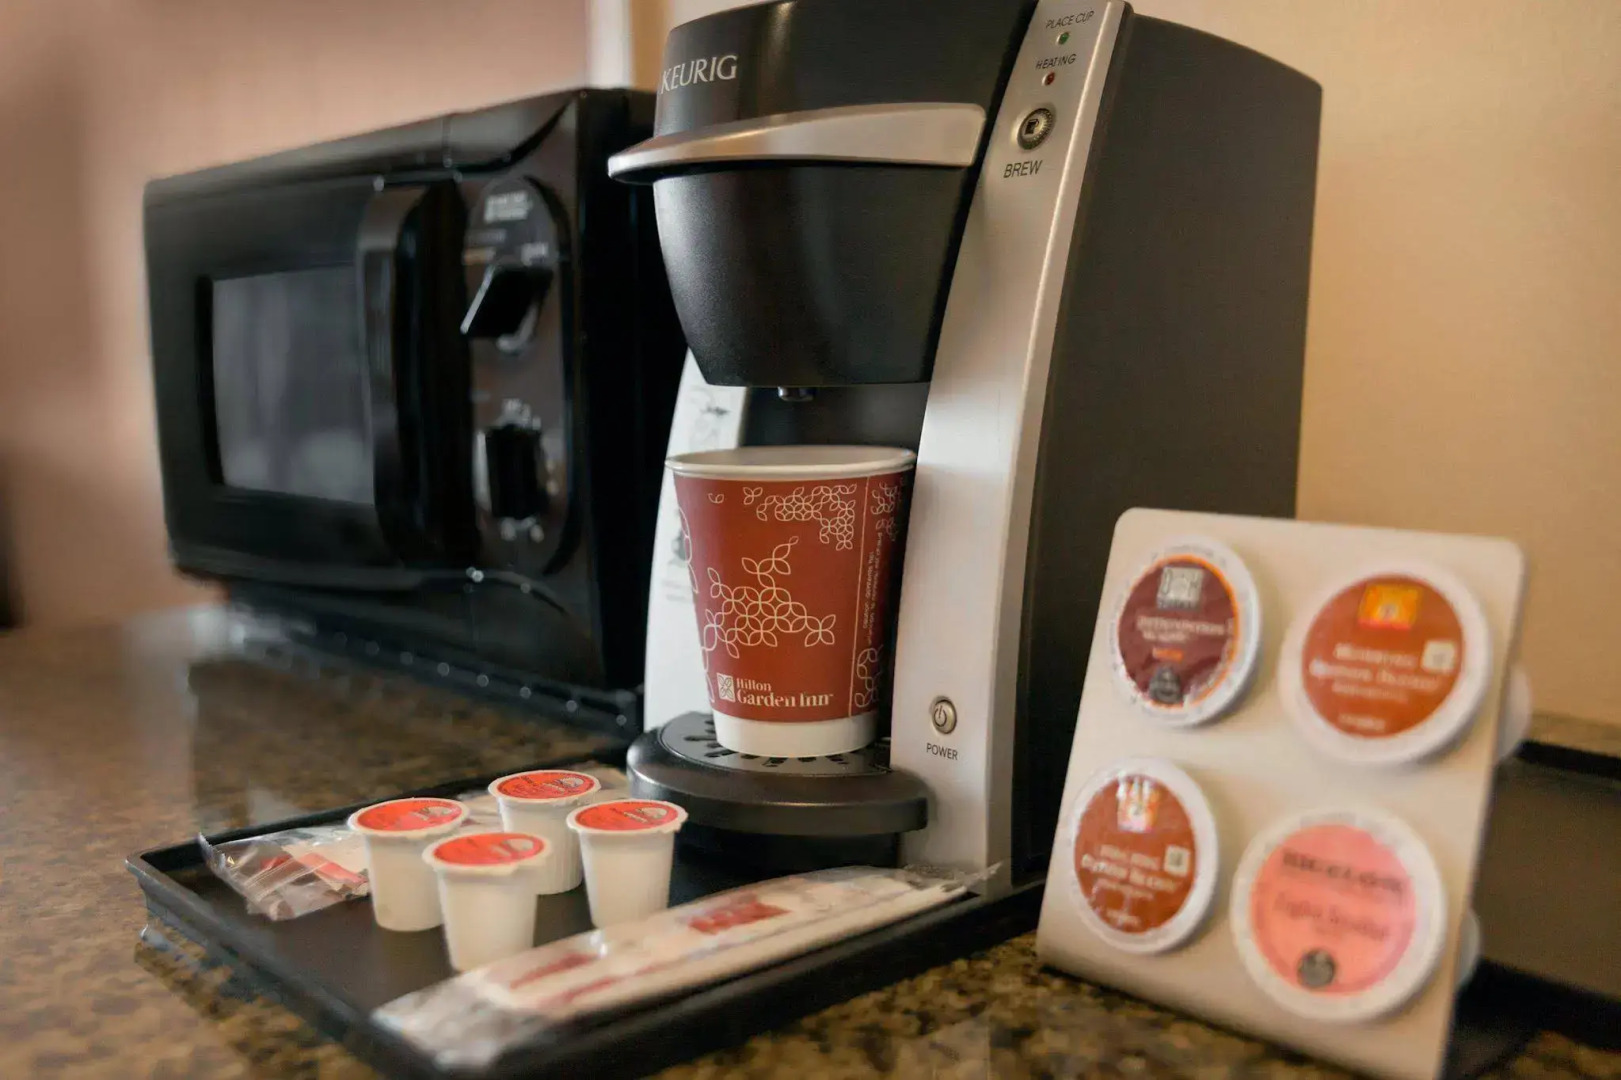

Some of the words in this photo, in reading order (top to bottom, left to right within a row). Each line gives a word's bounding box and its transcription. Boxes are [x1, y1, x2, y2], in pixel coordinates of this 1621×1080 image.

[1046, 14, 1074, 29] PLACE
[1075, 10, 1095, 24] CUP
[1036, 53, 1077, 70] HEATING
[660, 54, 738, 94] KEURIG
[1003, 160, 1043, 179] BREW
[736, 678, 772, 692] Hilton
[736, 689, 796, 707] Garden
[926, 742, 958, 760] POWER
